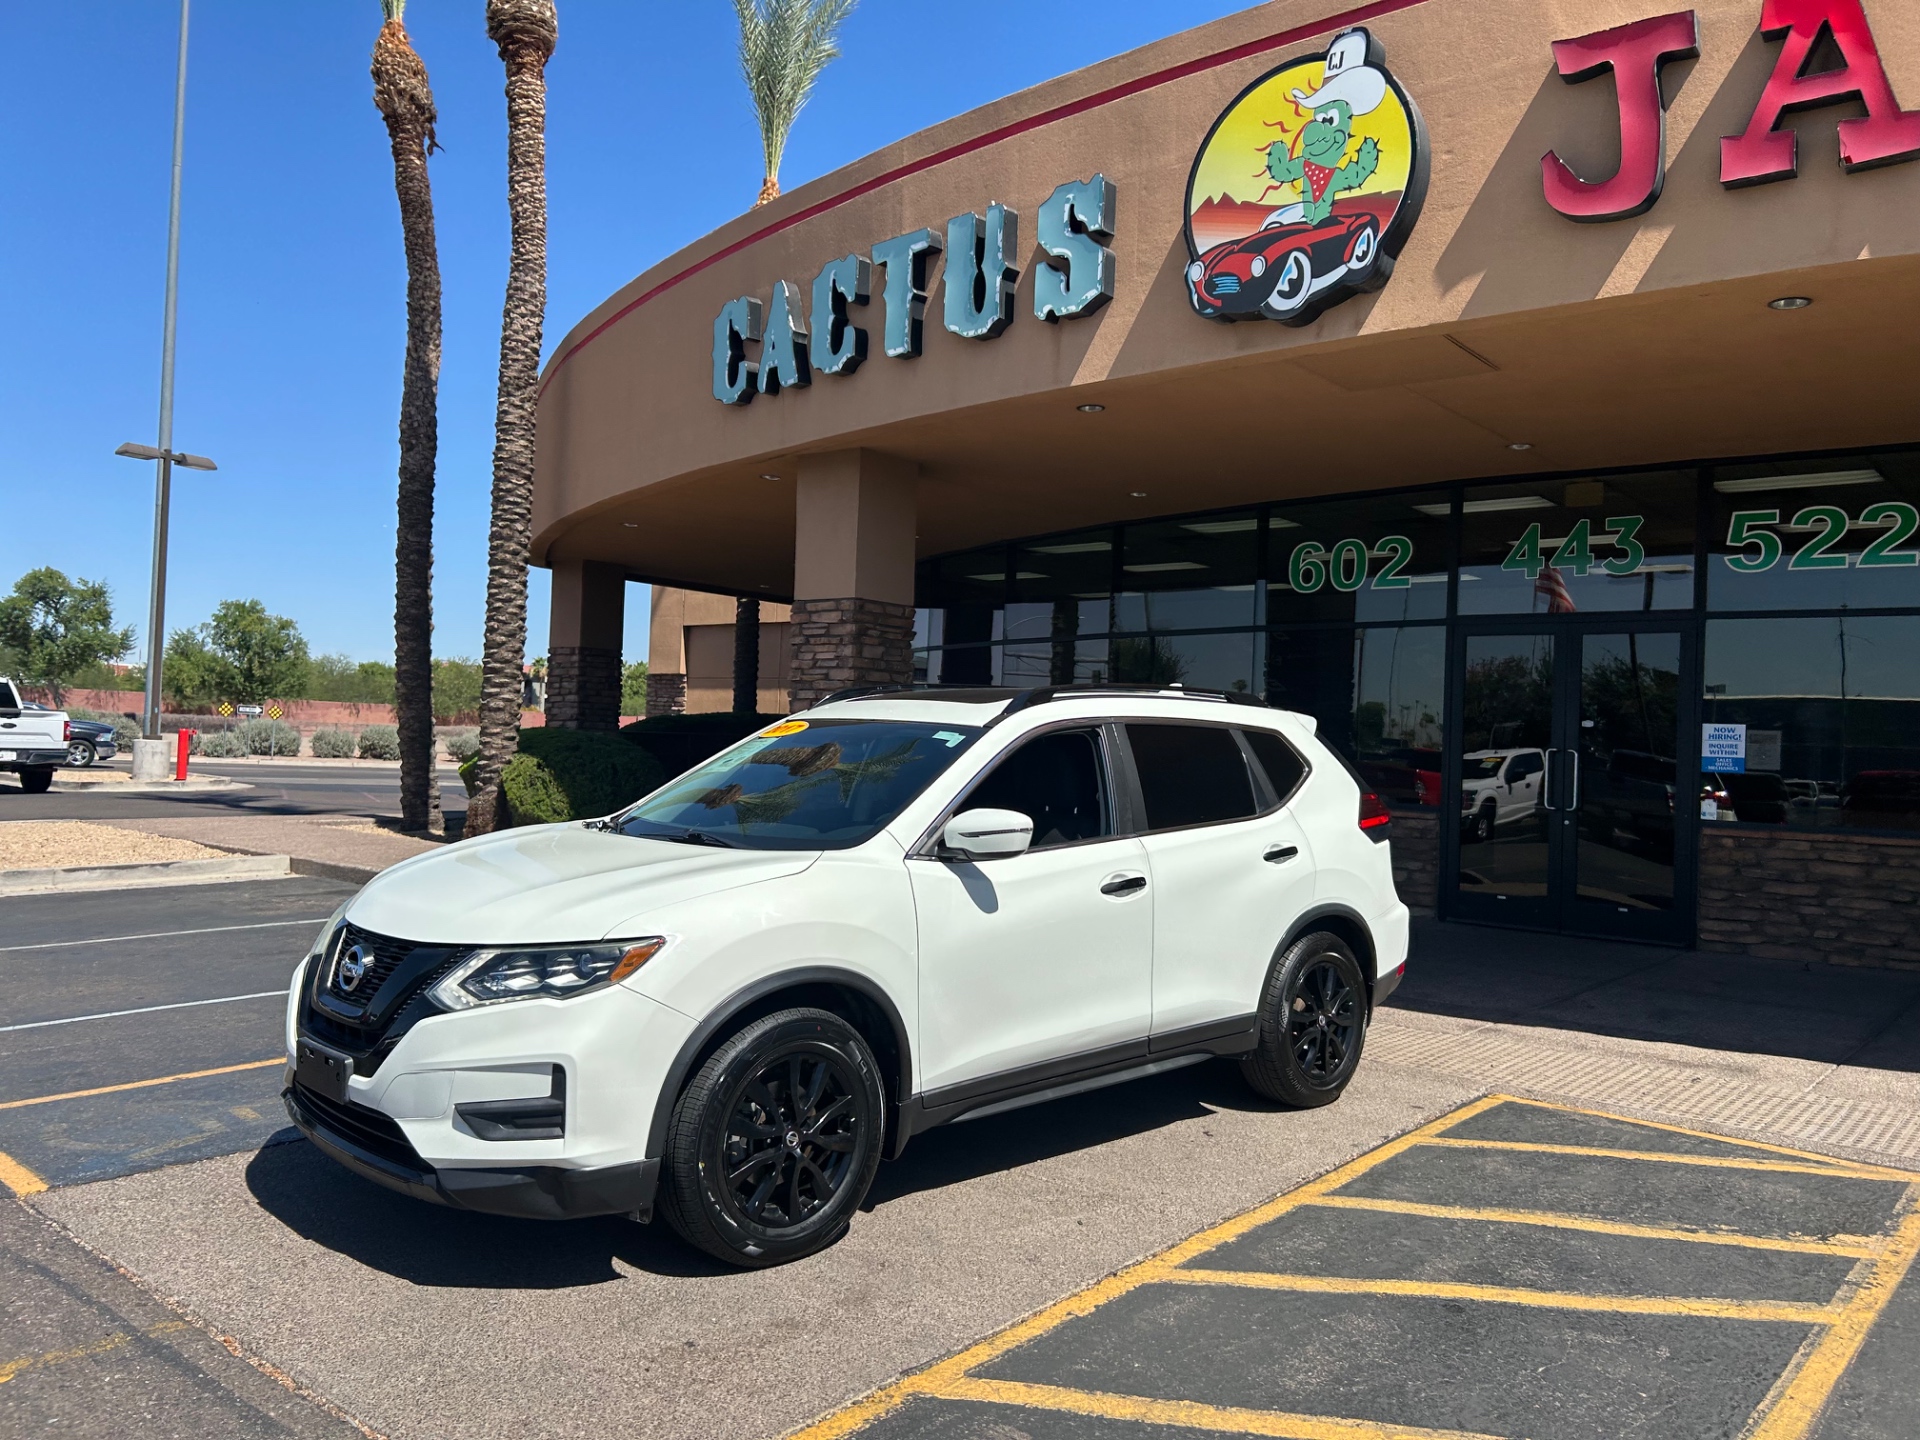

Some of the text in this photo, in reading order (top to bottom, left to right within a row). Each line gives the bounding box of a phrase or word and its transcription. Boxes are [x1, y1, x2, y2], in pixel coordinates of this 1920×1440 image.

[1328, 50, 1345, 71] CJ
[711, 172, 1117, 406] CACTUS
[1288, 501, 1919, 593] 602 443 522
